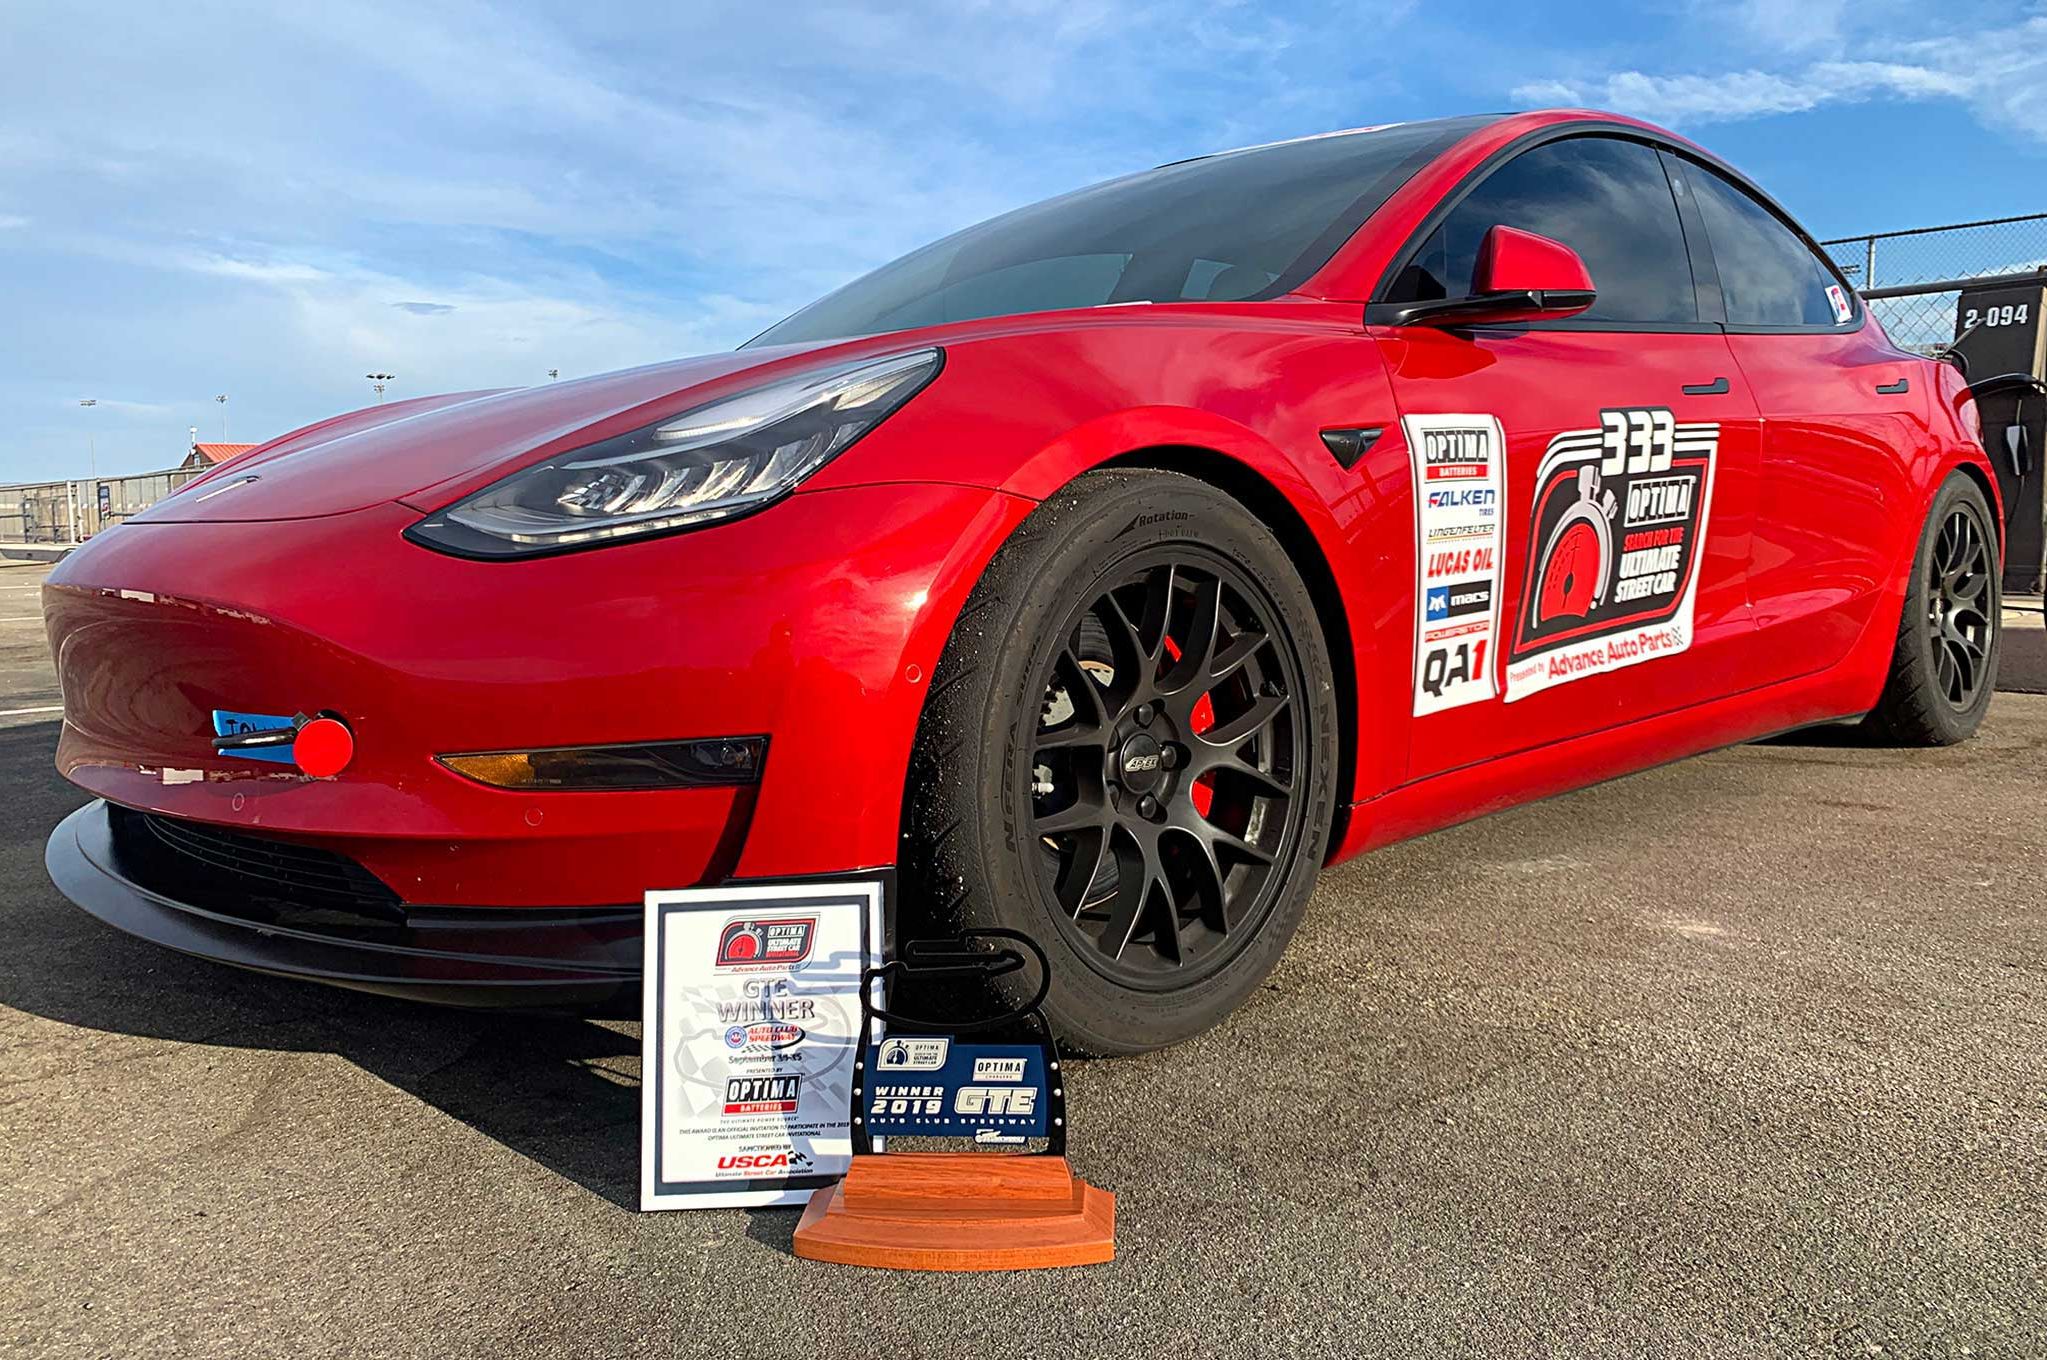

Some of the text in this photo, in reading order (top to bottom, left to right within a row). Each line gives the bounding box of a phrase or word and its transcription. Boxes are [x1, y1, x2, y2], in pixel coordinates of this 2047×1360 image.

[1426, 433, 1488, 460] OPTIMA
[1601, 410, 1675, 476] 333
[1439, 466, 1477, 477] BATTERIES
[1428, 489, 1495, 508] FALKEN
[1629, 484, 1689, 519] OPTIMA
[1139, 510, 1188, 527] Rotation
[1479, 508, 1494, 516] TIRES
[1428, 524, 1495, 538] LINGENFELTER
[1427, 547, 1493, 578] LUCAS OIL
[1619, 544, 1682, 579] ULTIMATE
[1614, 571, 1677, 603] STREET CAR
[1549, 648, 1604, 679] Advance
[1607, 640, 1637, 663] Auto
[1638, 631, 1673, 654] Parts
[1422, 639, 1488, 697] QA1
[1307, 704, 1331, 860] NEXEN
[769, 926, 804, 936] OPTIMA
[743, 977, 788, 999] GTE
[716, 999, 815, 1022] WINNER
[748, 1025, 798, 1034] AUTO CLUB
[748, 1033, 796, 1042] SPEEDWAY
[728, 1053, 776, 1065] September
[977, 1062, 1021, 1072] OPTIMA
[728, 1079, 796, 1101] OPTIMA
[875, 1086, 944, 1096] WINNER
[740, 1103, 783, 1112] BATTERIES
[870, 1100, 943, 1115] 2019
[954, 1086, 1038, 1115] GTE
[787, 1122, 819, 1130] PARTICIPATE
[718, 1153, 788, 1169] USCA
[778, 1167, 813, 1175] Association
